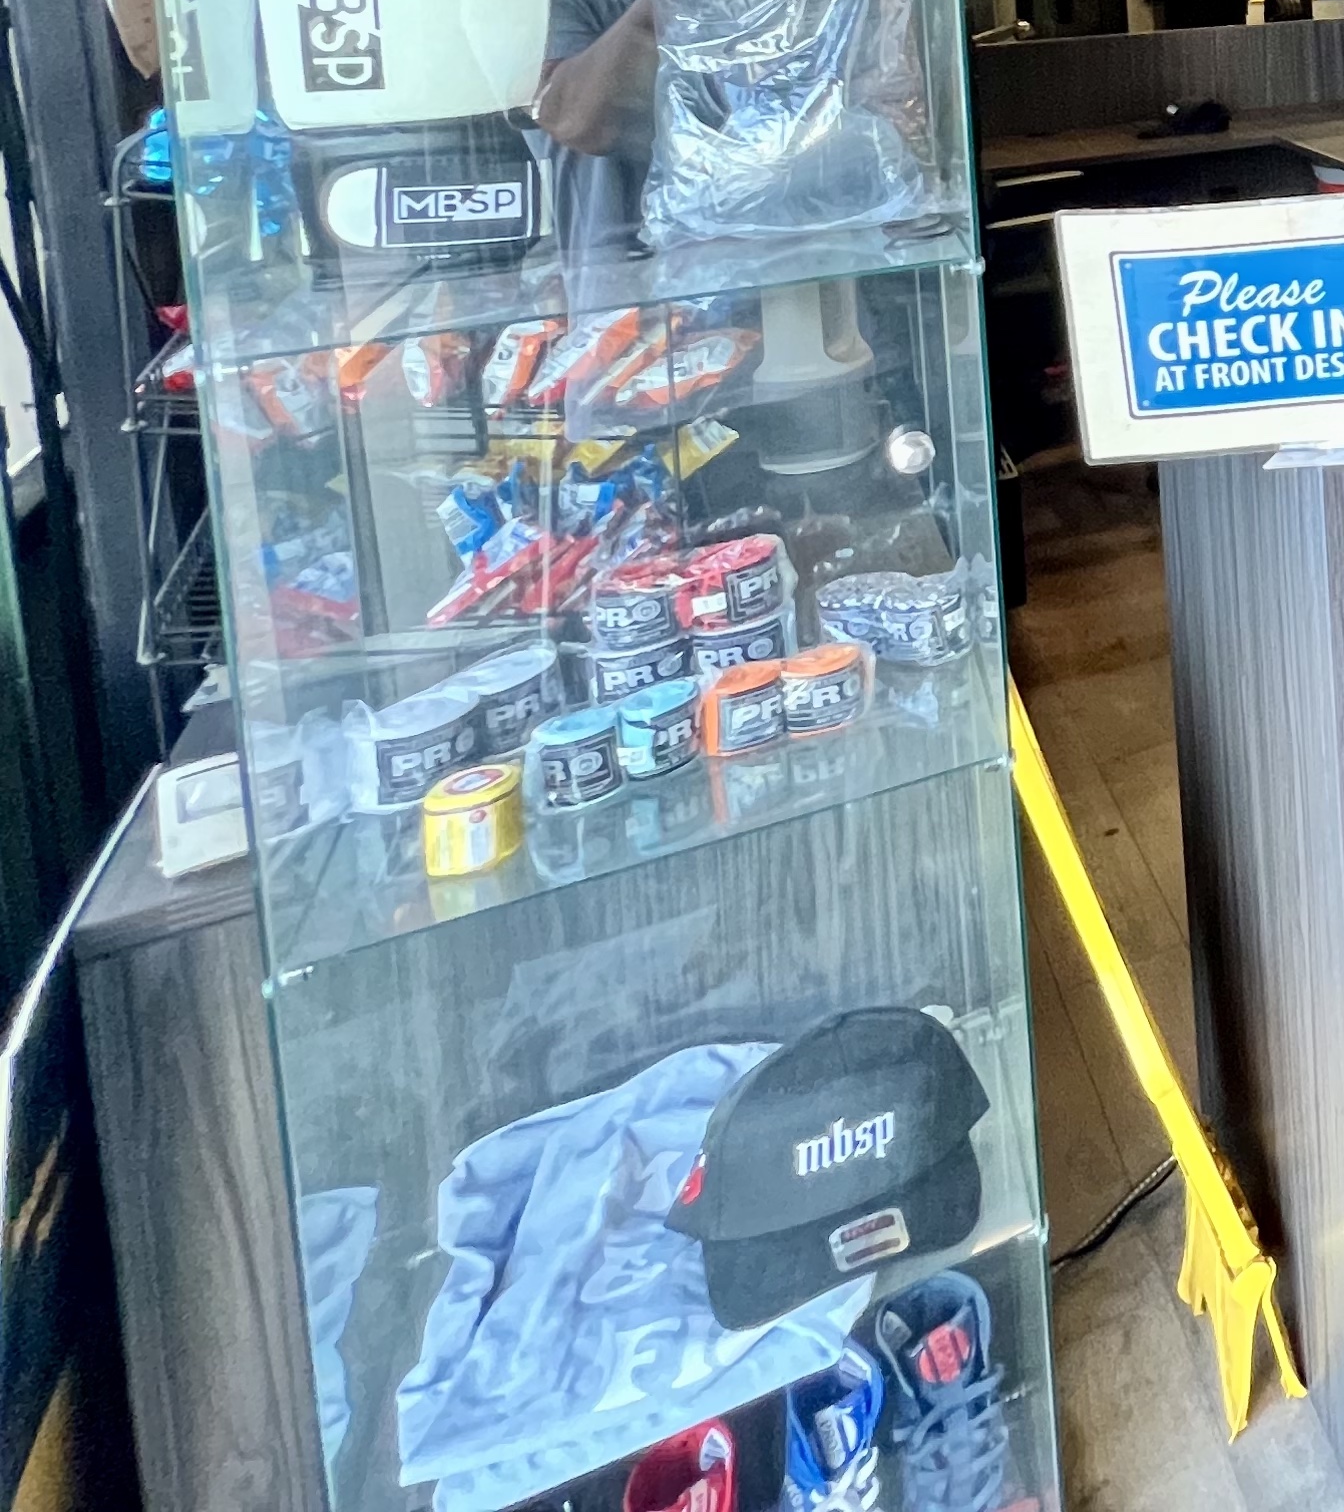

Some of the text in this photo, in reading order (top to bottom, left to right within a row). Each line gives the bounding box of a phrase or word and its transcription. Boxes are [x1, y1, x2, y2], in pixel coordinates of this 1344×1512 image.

[400, 188, 516, 218] MBSP
[1178, 270, 1326, 317] Please
[1148, 312, 1301, 364] CHECK
[1155, 364, 1187, 392] AT
[1195, 355, 1288, 390] FRONT
[796, 1111, 895, 1177] mbsp
